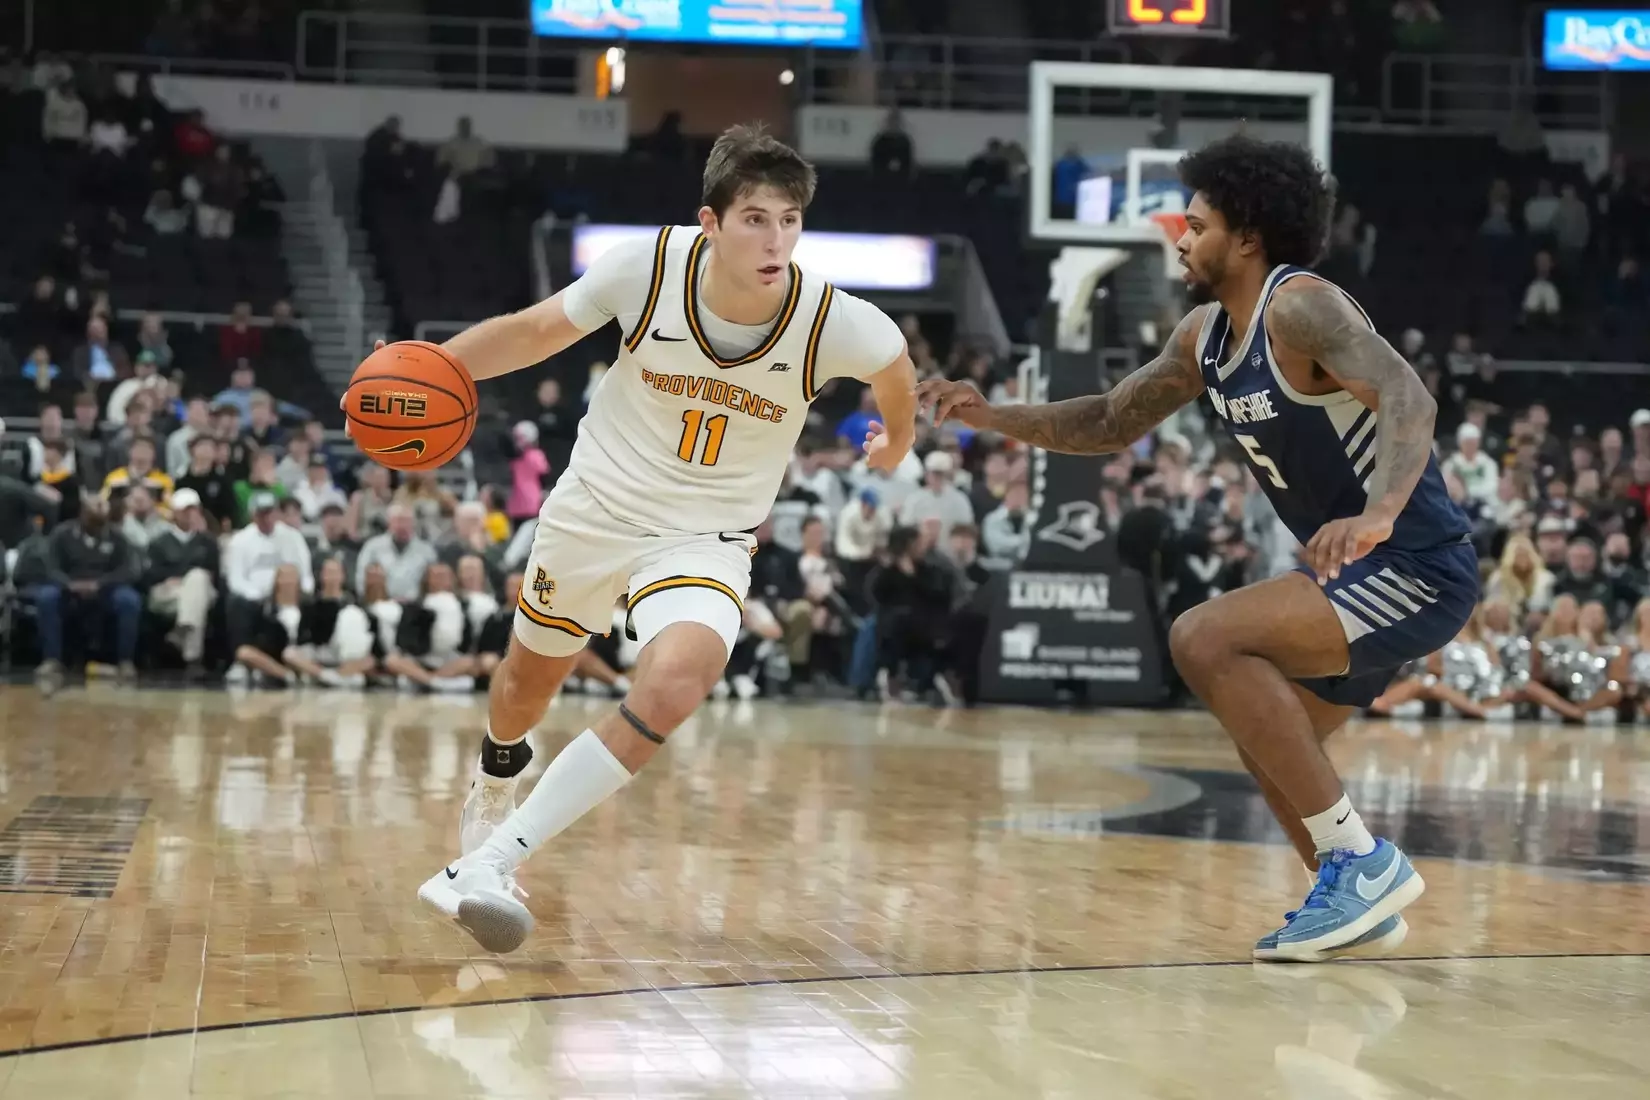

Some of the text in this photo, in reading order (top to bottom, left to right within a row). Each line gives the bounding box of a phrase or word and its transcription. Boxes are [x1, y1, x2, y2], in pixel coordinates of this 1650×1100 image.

[641, 368, 788, 424] PROVIDENCE
[677, 409, 730, 467] 11
[1234, 433, 1289, 490] 5
